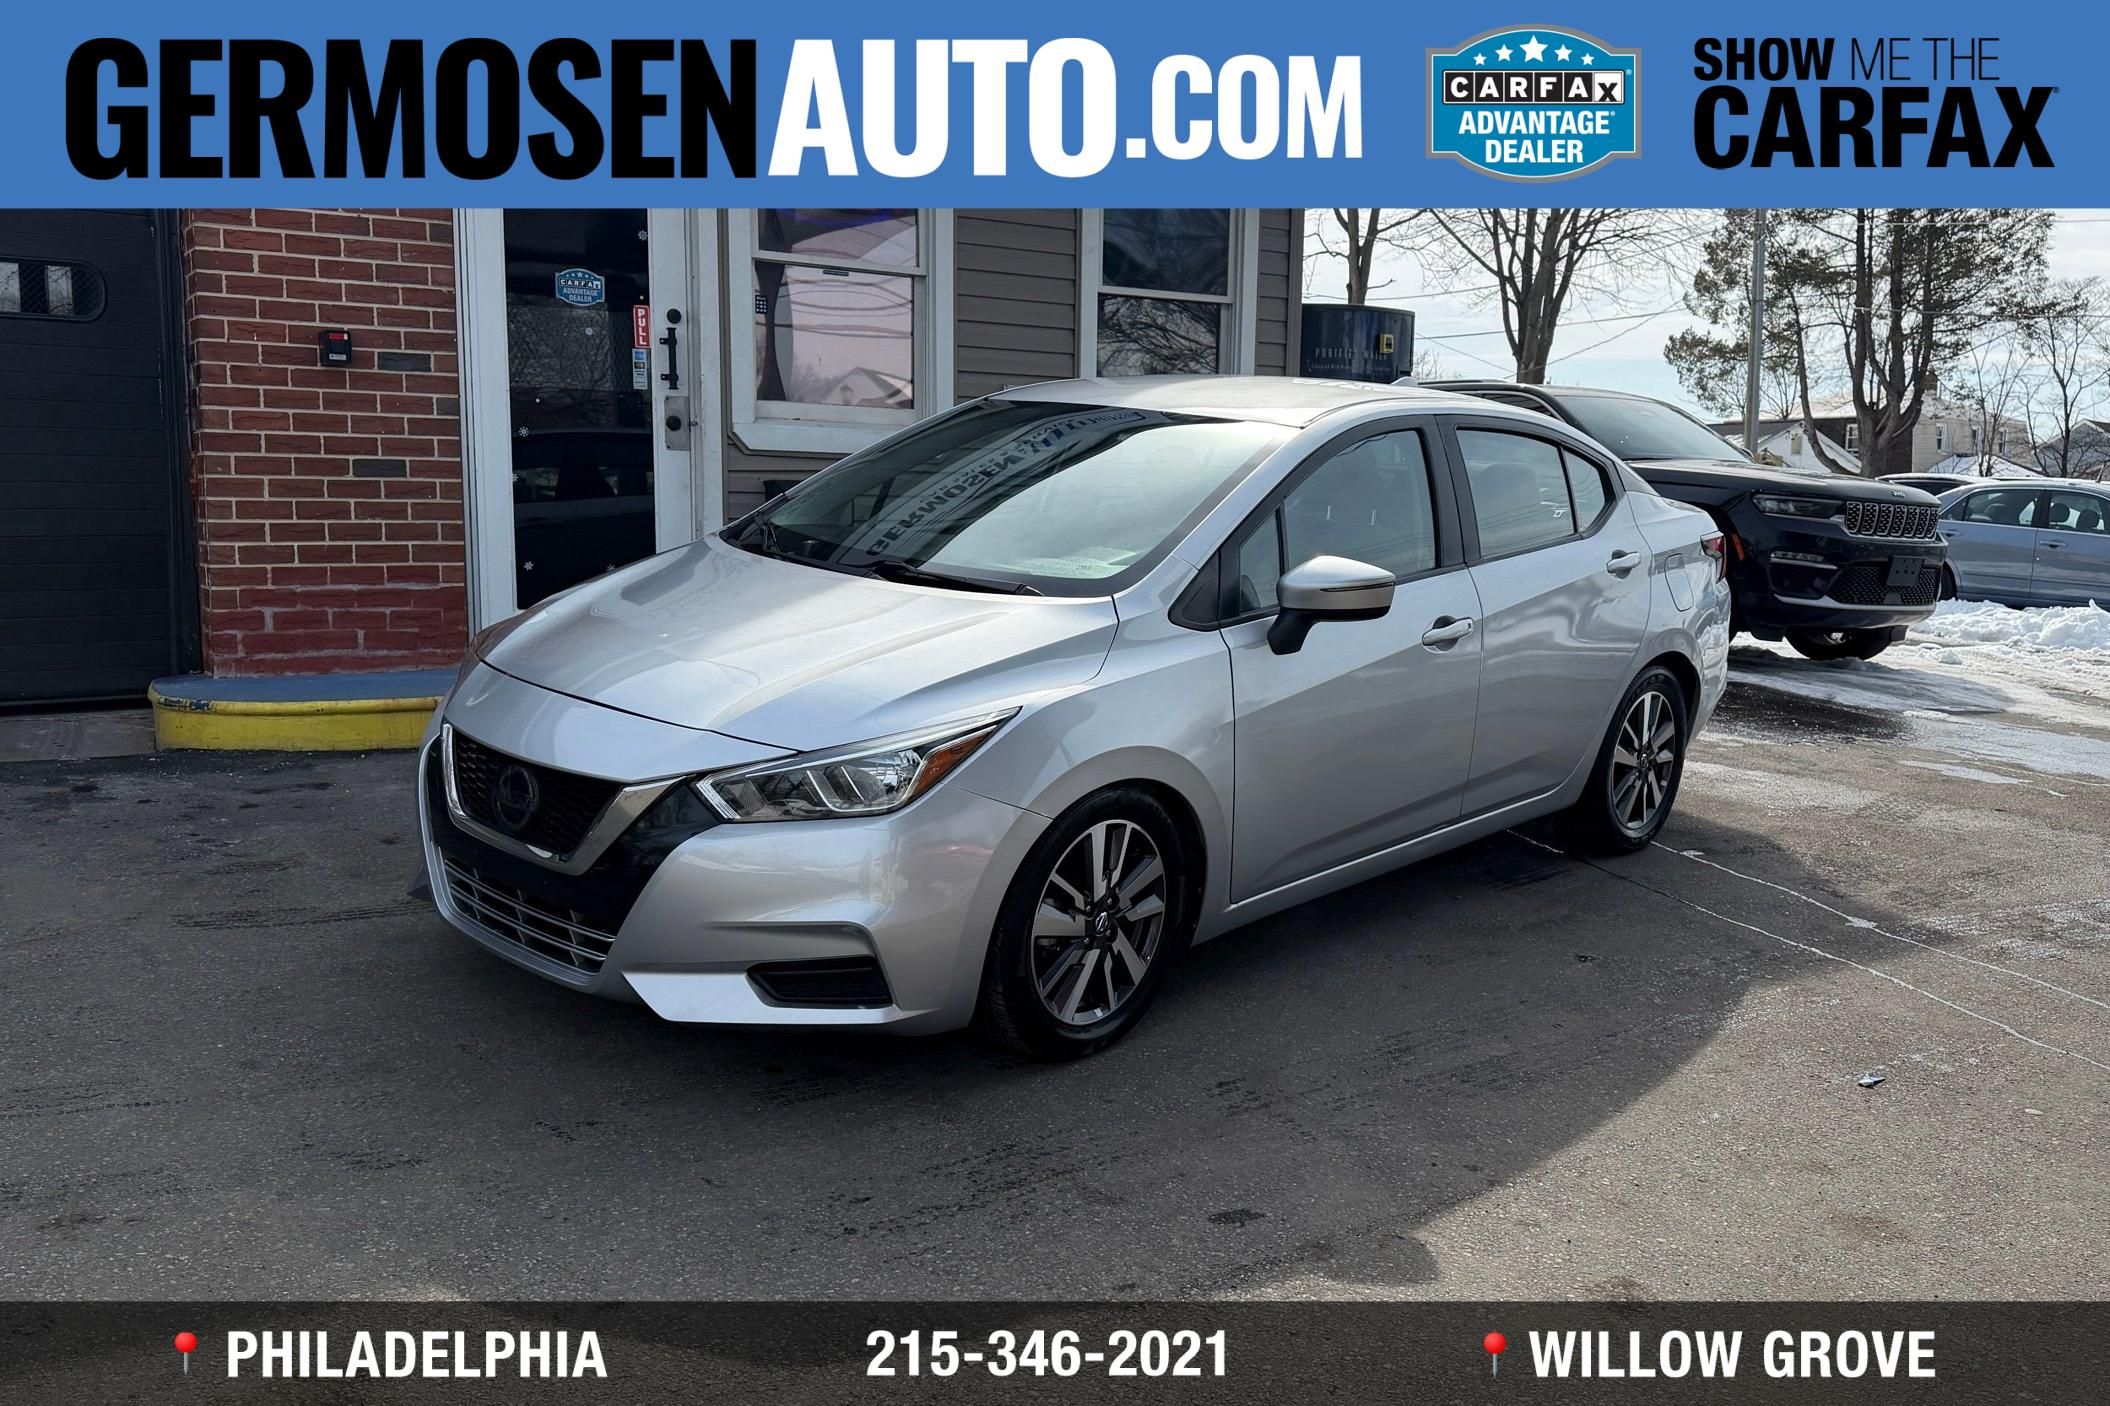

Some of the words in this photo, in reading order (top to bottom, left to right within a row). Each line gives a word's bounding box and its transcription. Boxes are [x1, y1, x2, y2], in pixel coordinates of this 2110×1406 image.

[560, 279, 600, 289] CARFAX
[562, 287, 599, 297] ADVANTAGE
[568, 294, 593, 303] DEALER
[637, 308, 647, 345] PULL
